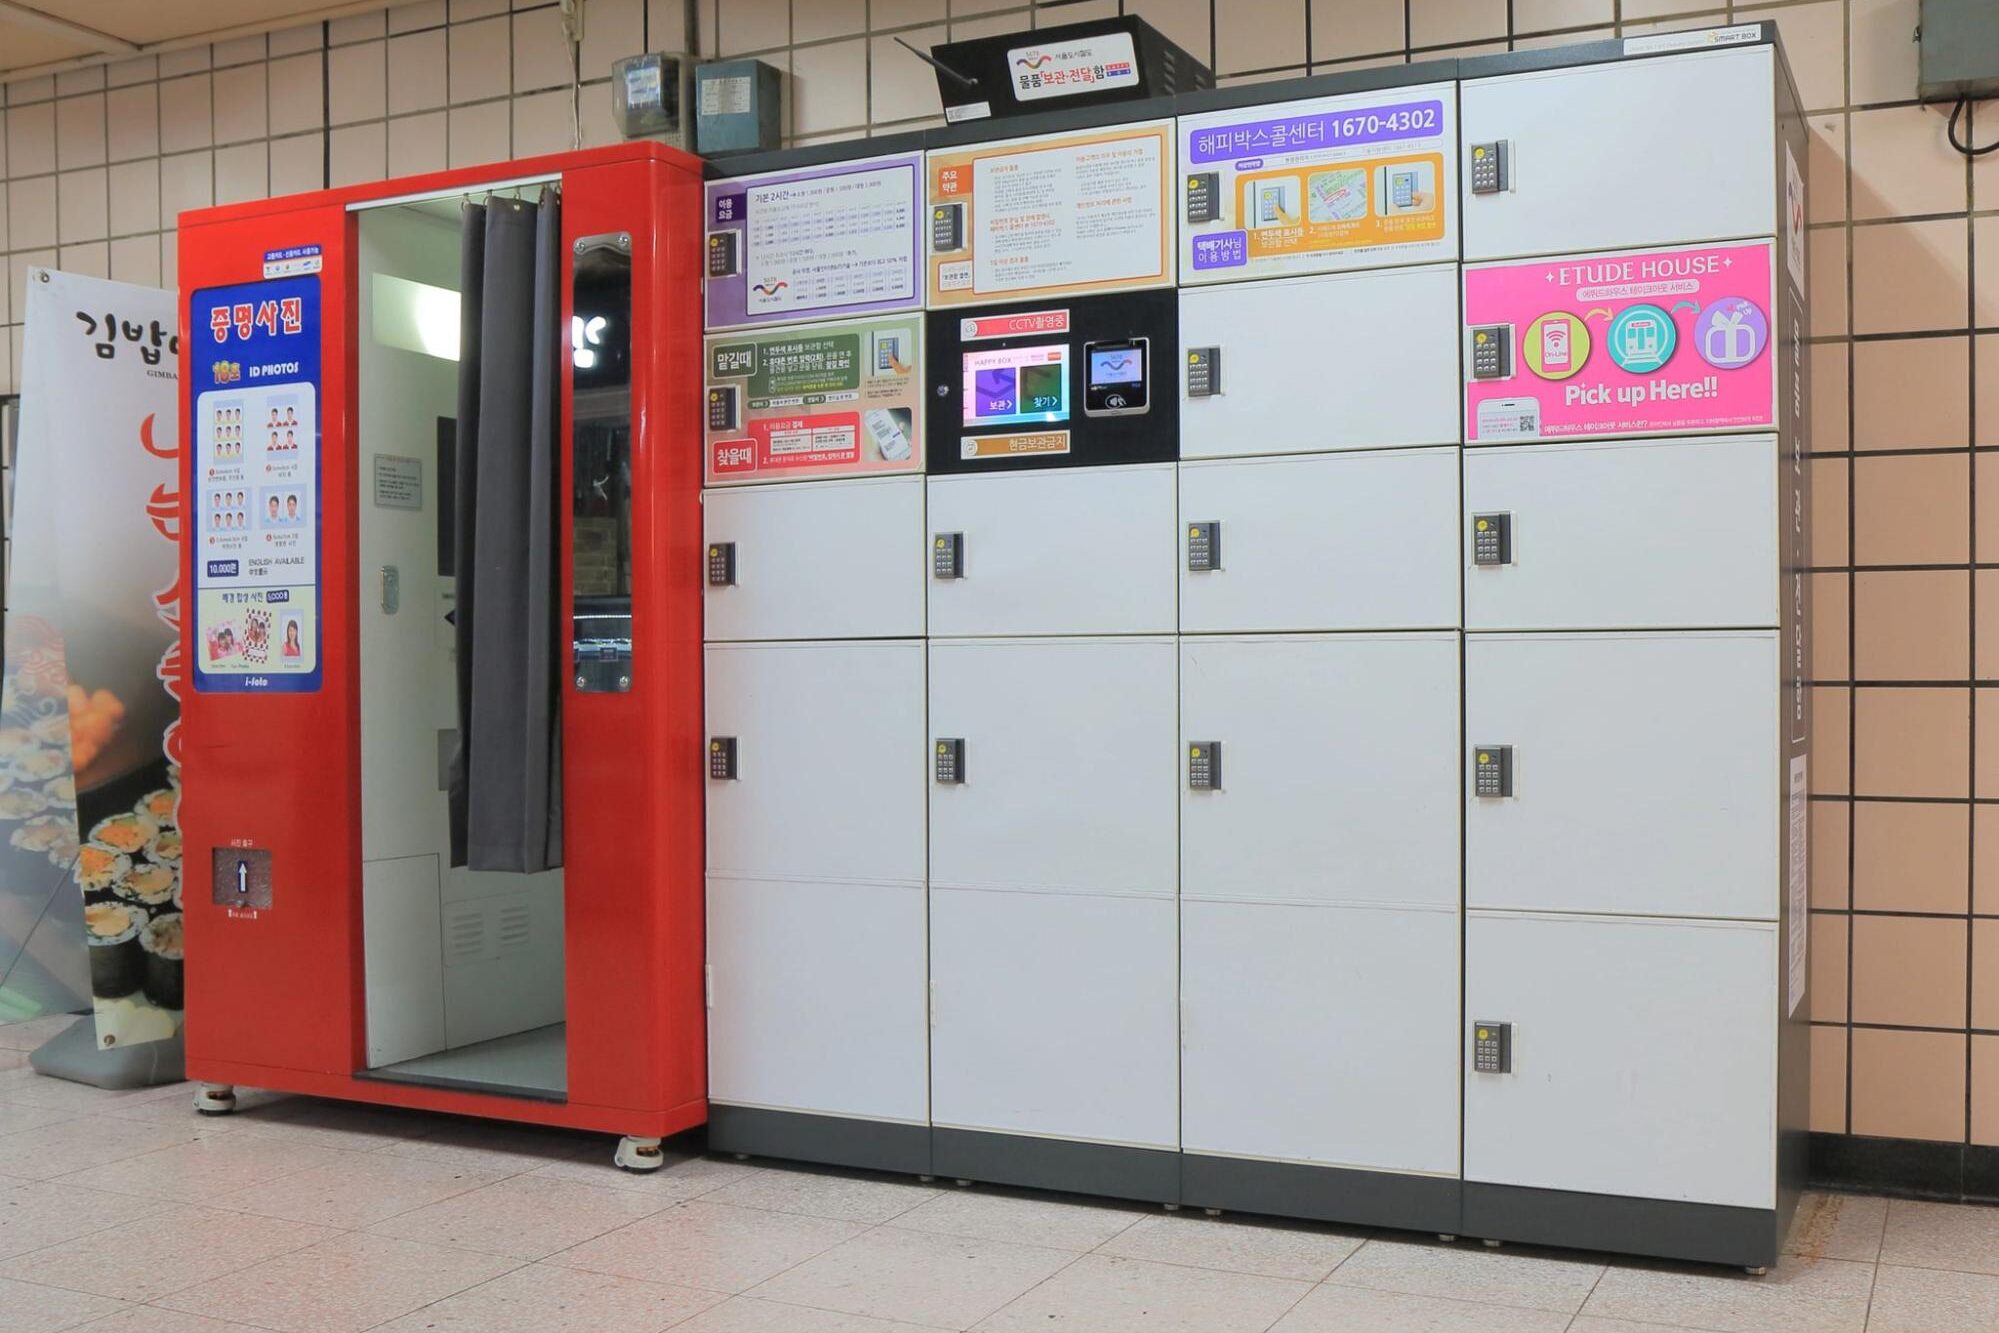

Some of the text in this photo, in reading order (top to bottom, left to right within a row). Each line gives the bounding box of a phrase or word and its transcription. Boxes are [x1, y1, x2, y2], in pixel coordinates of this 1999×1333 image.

[1198, 120, 1325, 156] 해피박스콜센터
[1332, 108, 1436, 138] 1670-4302
[1559, 255, 1720, 286] ETUDE HOUSE
[210, 297, 302, 343] 증명사진
[1008, 314, 1065, 331] CCTV촬영중
[249, 361, 299, 378] ID PHOTOS
[717, 350, 752, 371] 맡길때
[1565, 376, 1718, 408] Pick up Here!!
[989, 399, 1006, 410] 보관
[1034, 396, 1051, 409] 찾기
[1008, 435, 1066, 451] 현금보관금지
[717, 447, 752, 467] 찾을때
